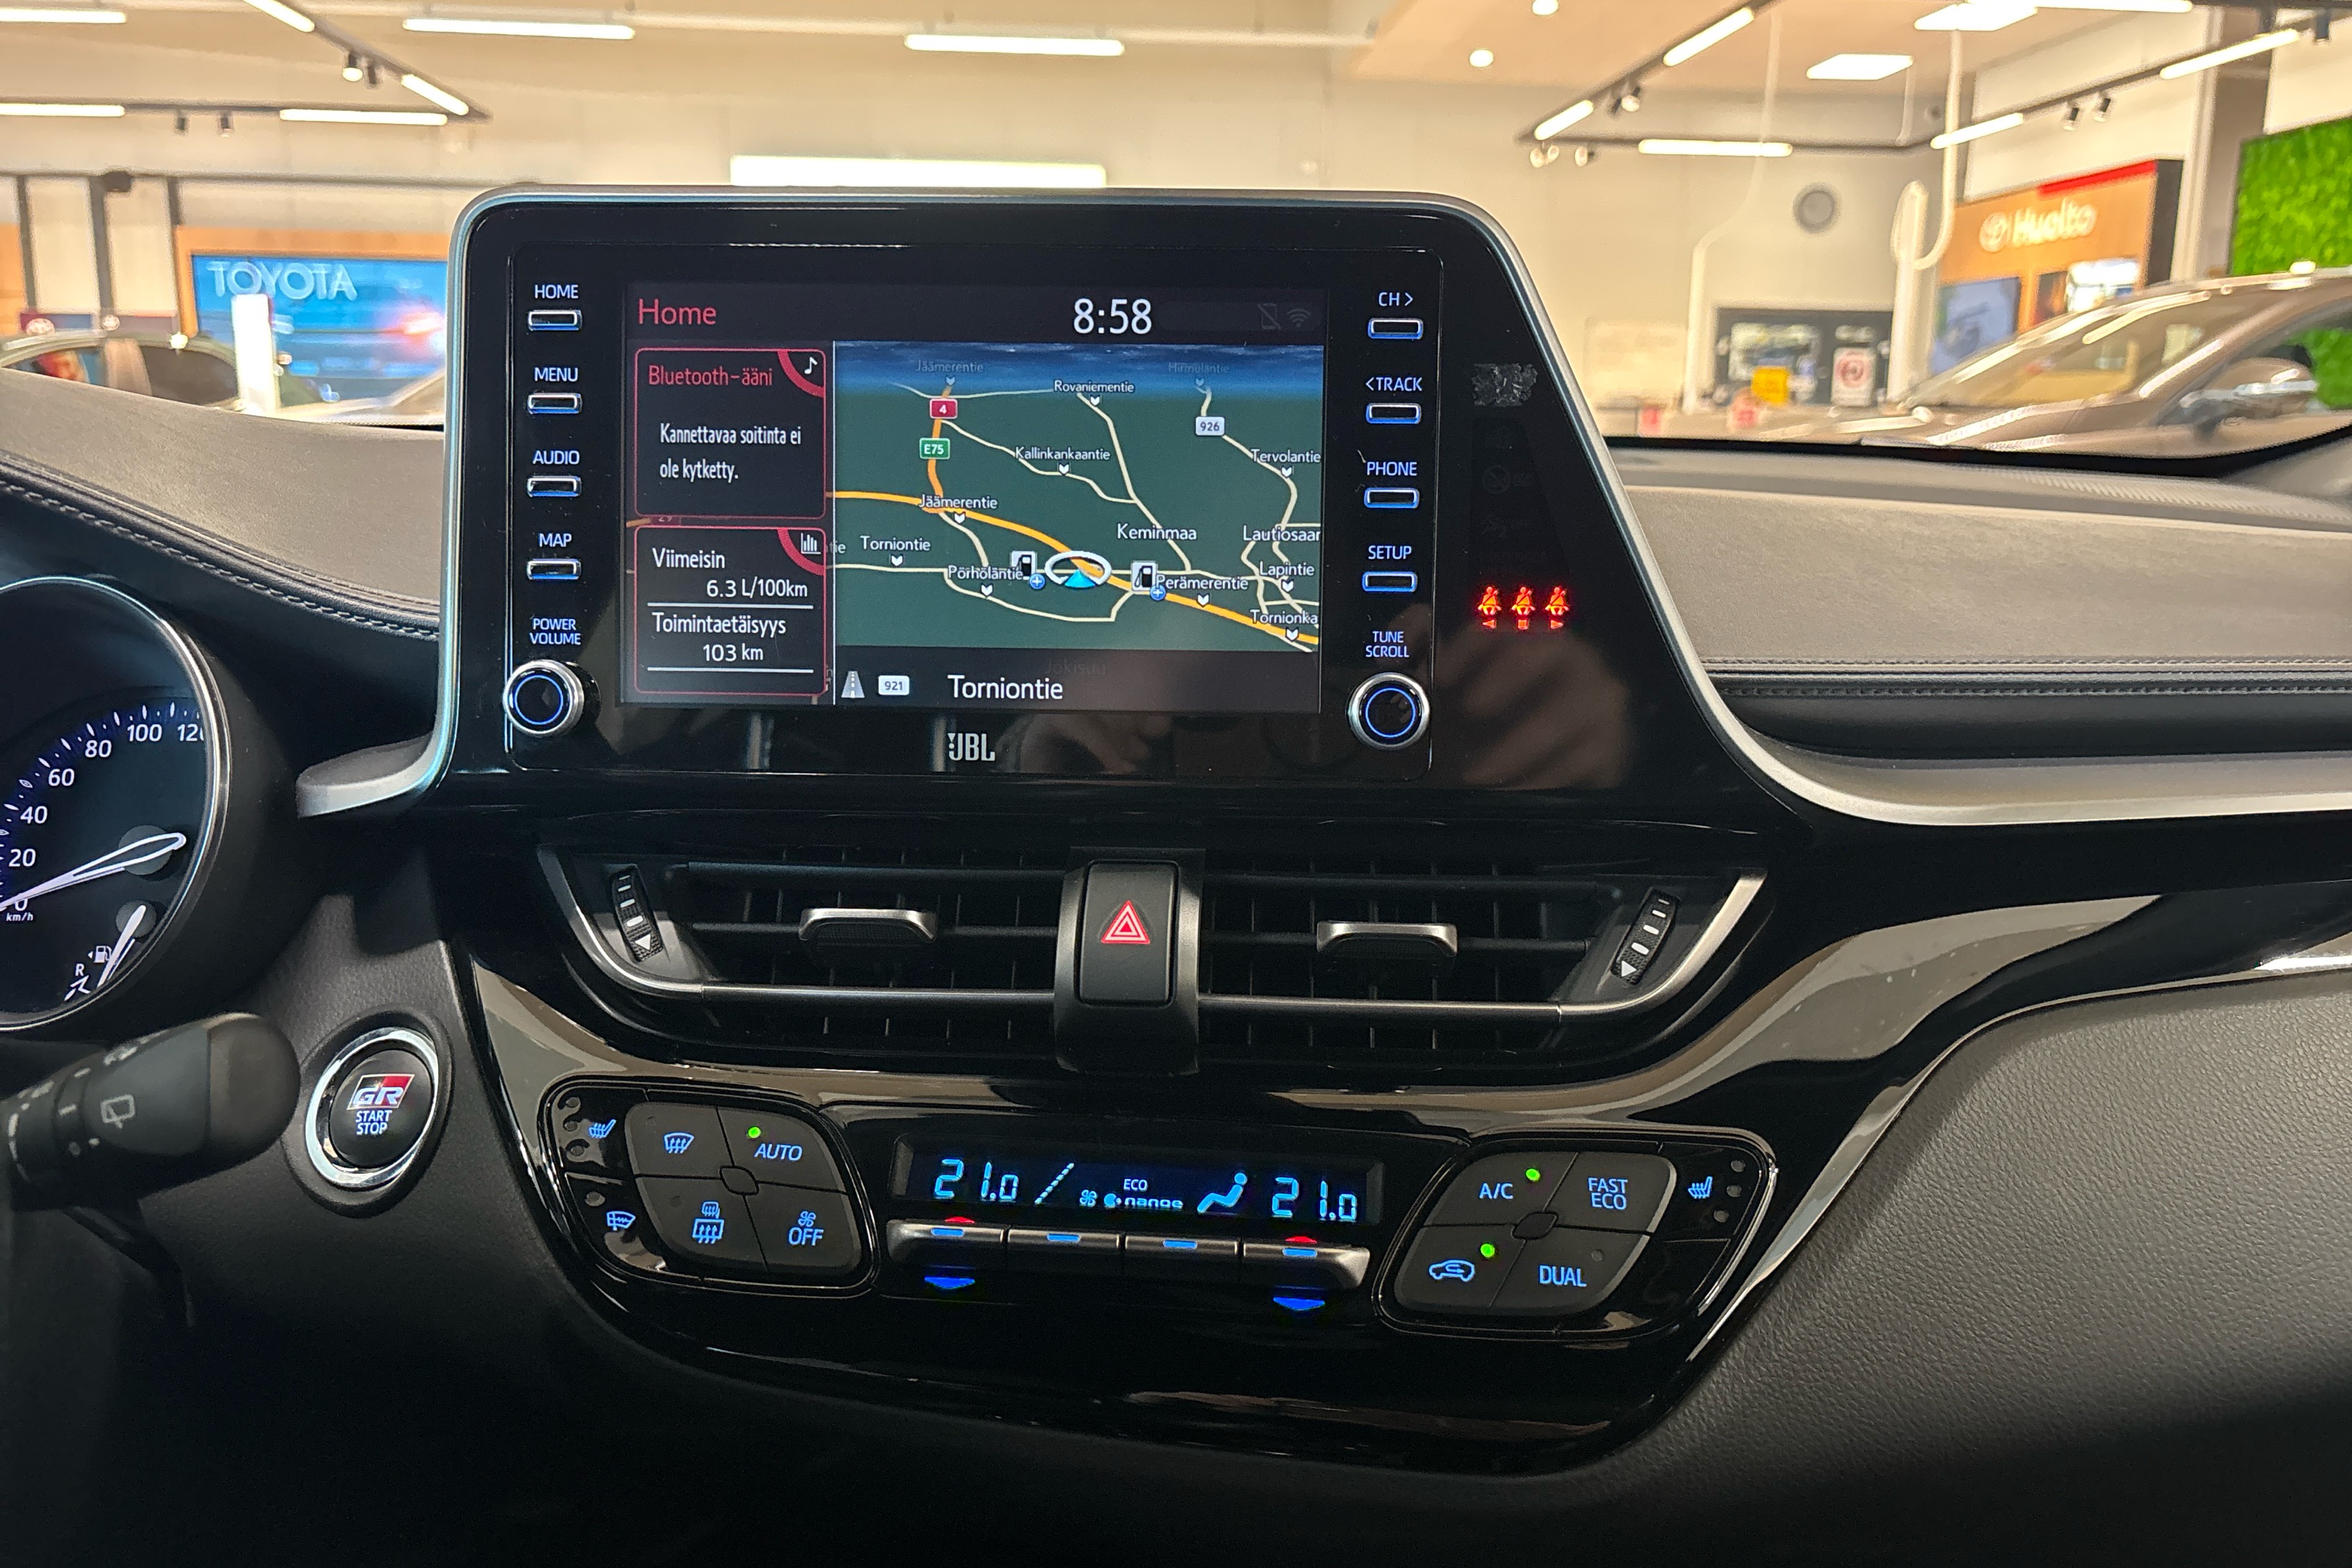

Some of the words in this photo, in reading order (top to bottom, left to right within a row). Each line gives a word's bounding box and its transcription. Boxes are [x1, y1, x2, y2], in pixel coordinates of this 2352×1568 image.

[207, 260, 358, 300] TOYOTA
[535, 284, 579, 299] HOME
[638, 298, 717, 325] Home
[1074, 298, 1152, 334] 8:58
[534, 368, 579, 382] MENU
[1054, 380, 1135, 393] Rovaniementie
[939, 405, 947, 414] 4
[659, 422, 736, 445] Kannettavaa
[739, 425, 785, 445] soitinta
[790, 427, 801, 445] ei
[1200, 422, 1220, 432] 926
[533, 450, 580, 465] AUDIO
[924, 444, 944, 455] E75
[1015, 447, 1110, 460] Kallinkankaantie
[1251, 449, 1321, 463] Tervolantie
[659, 458, 679, 478] ole
[682, 458, 739, 484] kytketty.
[1366, 461, 1417, 476] PHONE
[919, 494, 998, 510] Jäämerentie
[1117, 523, 1198, 540] Keminmaa
[538, 533, 572, 548] MAP
[860, 535, 932, 552] Torniontie
[651, 548, 726, 569] Viimeisin
[1368, 545, 1412, 560] SETUP
[1260, 561, 1315, 579] Lapintie
[706, 579, 737, 598] 6.3
[741, 576, 808, 599] L/100km
[1157, 575, 1249, 590] Perämerentie
[533, 618, 576, 631] POWER
[652, 612, 787, 638] Toimintaetäisyys
[529, 633, 582, 646] VOLUME
[1373, 631, 1404, 643] TUNE
[703, 644, 738, 662] 103
[741, 643, 765, 662] km
[1366, 646, 1409, 658] SCROLL
[884, 681, 903, 691] 921
[948, 674, 1063, 700] Torniontie
[128, 724, 162, 742] 100
[84, 739, 112, 758] 80
[948, 733, 995, 761] JBL
[48, 768, 75, 786] 60
[20, 806, 48, 824] 40
[9, 849, 37, 866] 20
[6, 912, 34, 922] km/h
[75, 964, 85, 976] R
[352, 1087, 404, 1105] GR
[355, 1110, 392, 1122] START
[356, 1123, 388, 1135] STOP
[754, 1144, 803, 1161] AUTO
[935, 1158, 1019, 1200] 21.0
[1123, 1179, 1148, 1191] ECO
[1587, 1177, 1628, 1193] FAST
[1271, 1177, 1358, 1220] 21.0
[1479, 1182, 1513, 1199] A/C
[1591, 1194, 1626, 1210] ECO
[788, 1227, 824, 1246] OFF
[1539, 1265, 1587, 1287] DUAL
